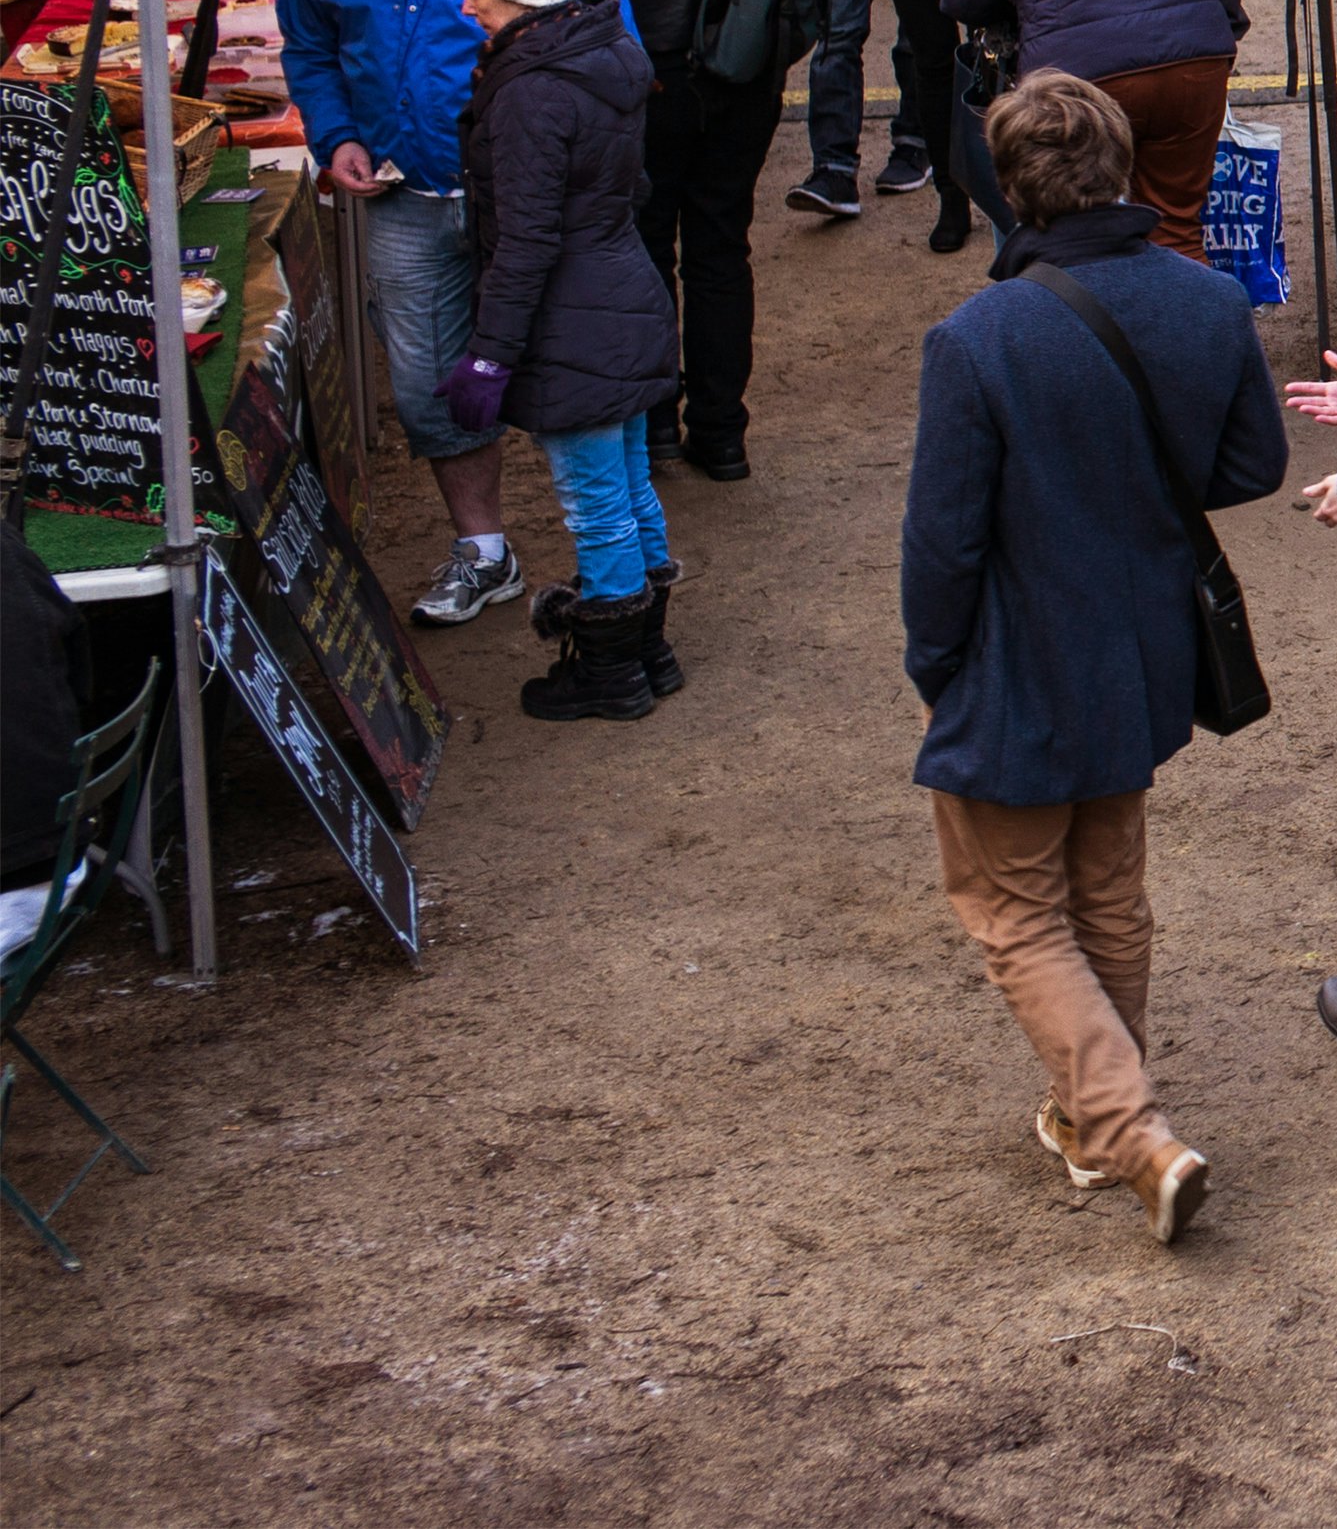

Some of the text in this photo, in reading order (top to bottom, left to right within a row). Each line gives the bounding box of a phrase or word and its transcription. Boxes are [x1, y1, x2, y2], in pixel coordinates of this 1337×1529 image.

[0, 87, 59, 123] food
[1206, 192, 1267, 215] PING
[1202, 223, 1263, 251] ALLY
[117, 291, 156, 318] Pork
[71, 328, 137, 362] Haggis
[43, 363, 86, 390] Pork
[41, 399, 82, 428] Pork
[89, 402, 163, 435] Stornow
[34, 426, 146, 470] black pudding
[67, 458, 141, 488] Special
